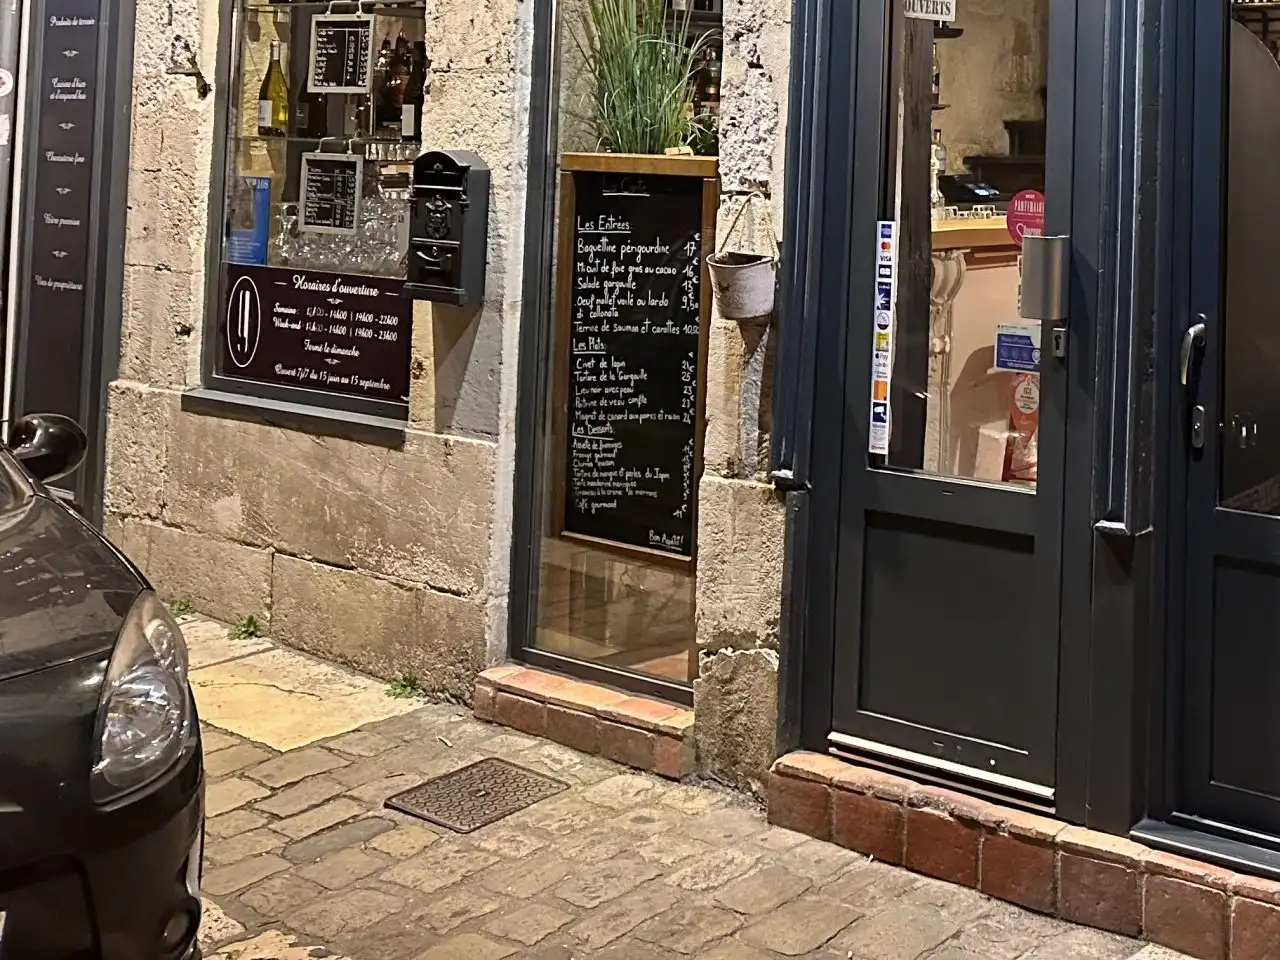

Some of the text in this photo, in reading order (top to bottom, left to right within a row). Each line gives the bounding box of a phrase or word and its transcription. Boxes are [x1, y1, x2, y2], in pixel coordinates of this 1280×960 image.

[577, 215, 595, 231] Les
[601, 258, 610, 273] de
[610, 260, 625, 279] foie
[655, 266, 677, 275] cacao
[293, 275, 380, 297] Horaires d'ouverture
[577, 276, 600, 290] Salade
[636, 298, 645, 306] au
[648, 289, 669, 306] lardo
[329, 309, 348, 320] 14h00
[356, 312, 374, 323] 19h00
[379, 315, 399, 326] 22h00
[577, 307, 584, 319] di
[329, 324, 347, 335] 14h00
[355, 327, 373, 338] 19h00
[378, 330, 398, 341] 23h00
[601, 319, 610, 332] de
[641, 318, 651, 334] et
[651, 320, 680, 335] carottes
[323, 341, 330, 354] le
[330, 344, 360, 357] dimanche
[573, 338, 586, 351] Les
[576, 355, 626, 373] Civet de lapin
[310, 369, 318, 380] du
[319, 371, 327, 381] 15
[327, 373, 340, 385] juin
[341, 376, 350, 384] au
[351, 375, 359, 386] 15
[359, 378, 391, 391] septembre
[600, 370, 608, 381] de
[610, 370, 616, 380] la
[620, 387, 634, 398] peau
[600, 397, 608, 406] de
[575, 410, 597, 425] Magret
[598, 410, 606, 420] de
[607, 409, 628, 420] canard
[658, 409, 664, 420] et
[572, 422, 585, 434] Les
[592, 440, 598, 450] de
[592, 468, 600, 478] de
[645, 467, 653, 478] du
[649, 529, 660, 541] Bon
